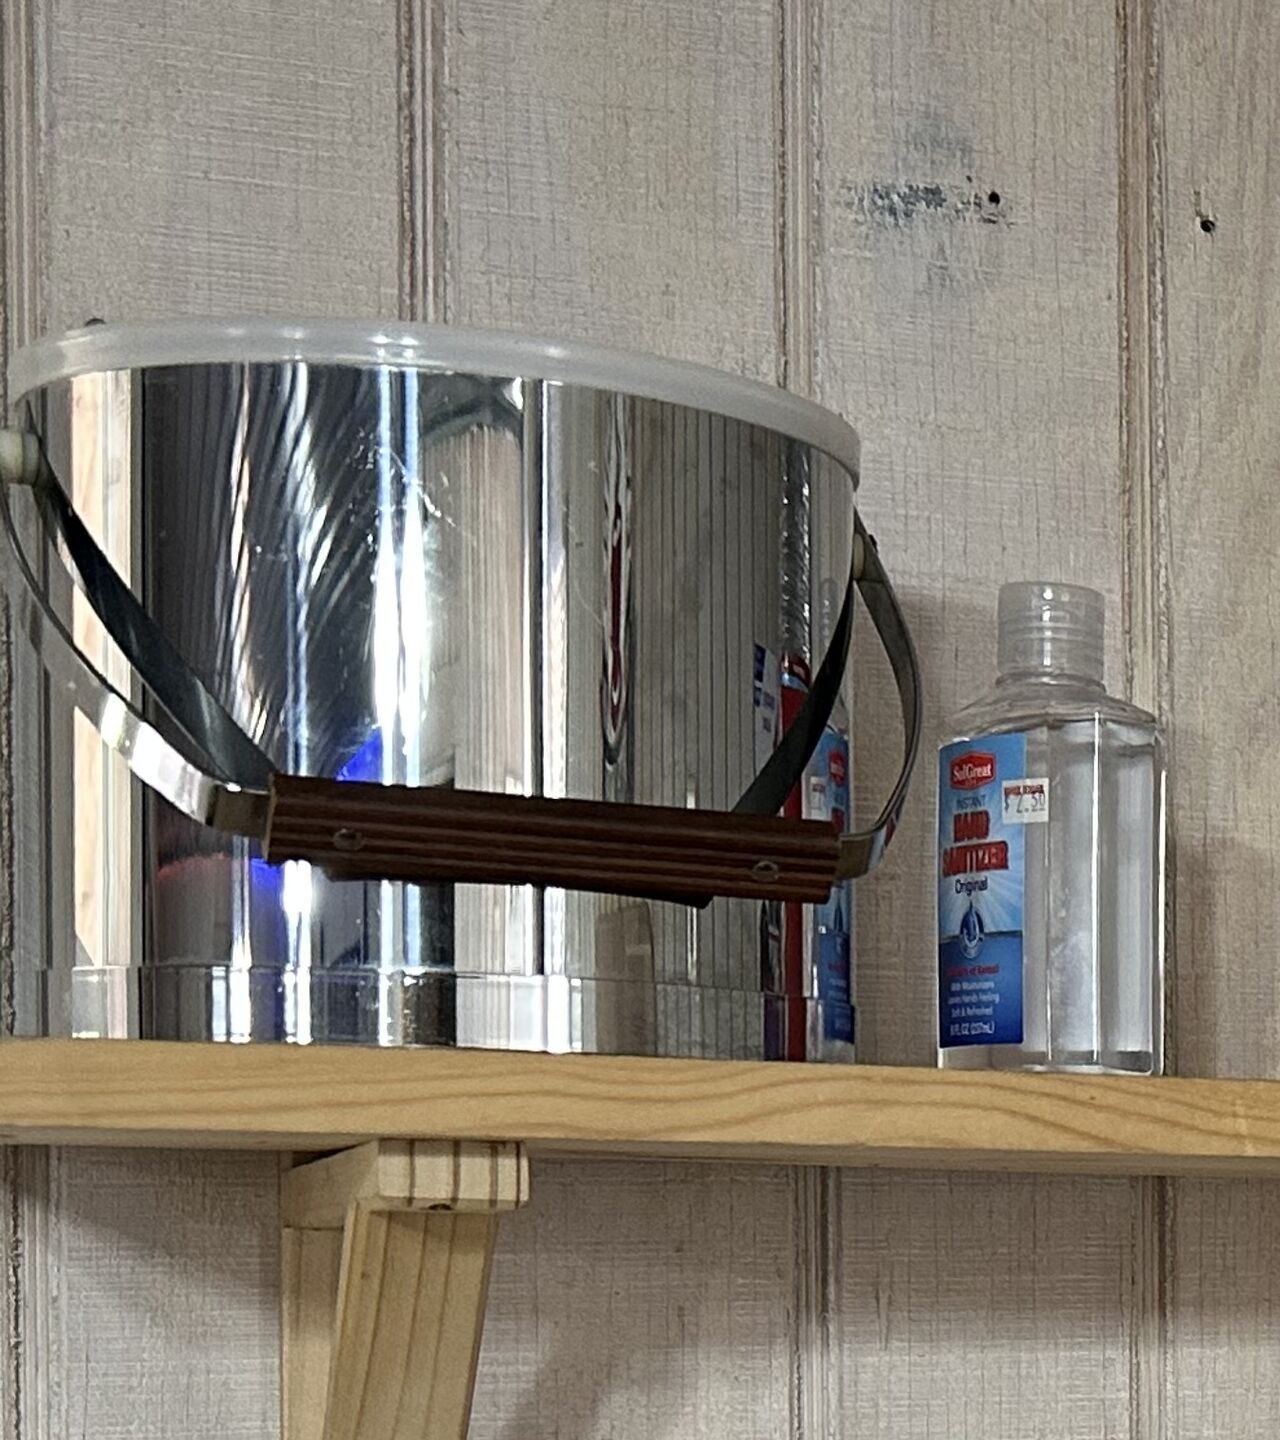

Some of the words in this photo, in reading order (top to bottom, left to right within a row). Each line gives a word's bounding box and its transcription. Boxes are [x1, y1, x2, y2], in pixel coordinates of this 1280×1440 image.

[957, 794, 986, 809] INSTANT
[953, 809, 990, 844] HAND
[943, 840, 1009, 878] SANITIZER
[955, 876, 988, 897] Original
